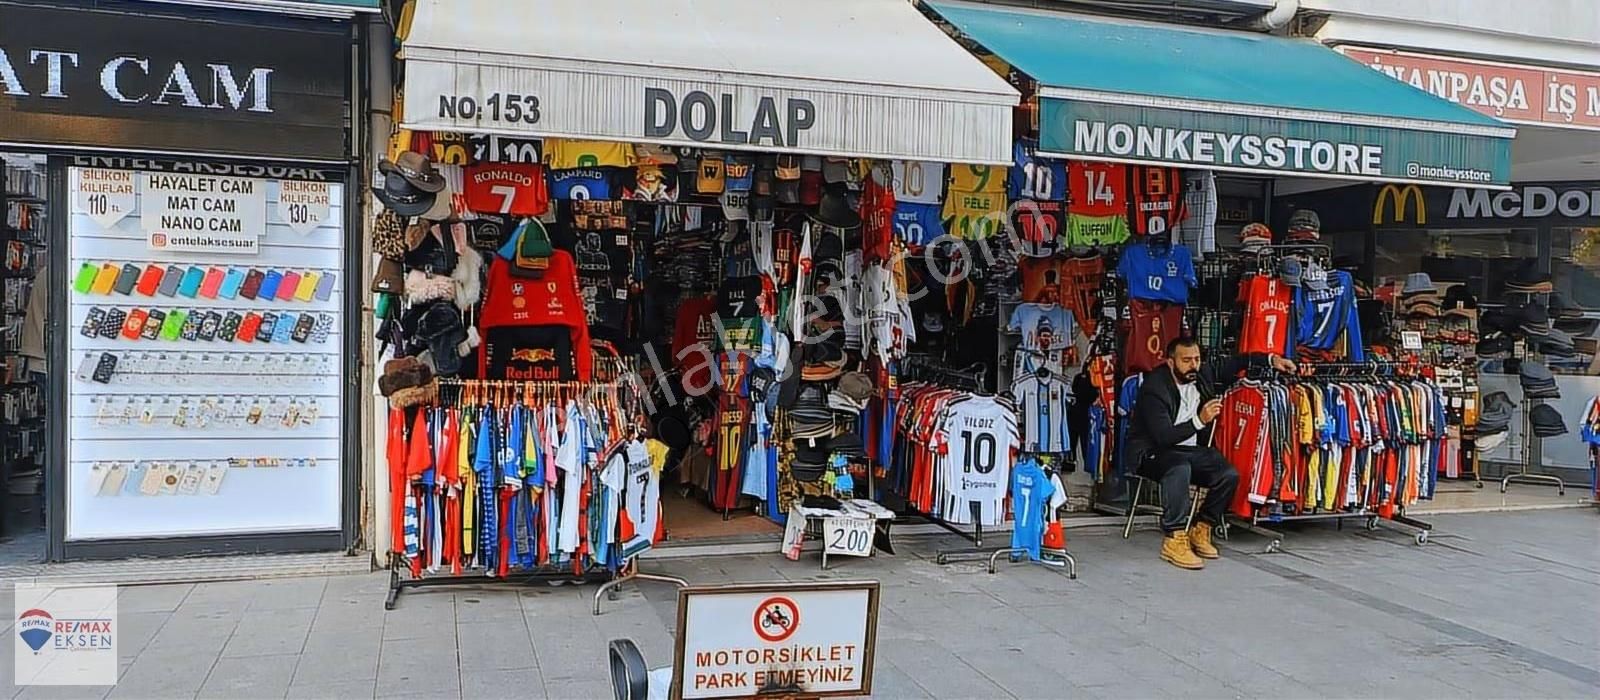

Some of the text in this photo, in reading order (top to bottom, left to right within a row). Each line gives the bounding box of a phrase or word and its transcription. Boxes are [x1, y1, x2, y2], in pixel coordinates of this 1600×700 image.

[100, 56, 275, 112] CAM
[1364, 56, 1529, 116] ANPAŞA
[1548, 75, 1577, 122] İŞ
[643, 87, 816, 147] DOLAP
[1073, 119, 1383, 176] MONKEYSSTORE
[149, 175, 254, 195] HAYALET CAM
[473, 170, 533, 187] RONALDO
[553, 169, 603, 182] LAMPARD
[1420, 165, 1491, 182] monkeysstore
[80, 181, 133, 195] KILIFLAR
[280, 193, 329, 206] KILIFLAR
[490, 185, 517, 213] 7
[1084, 170, 1115, 207] 14
[87, 195, 107, 216] 110
[167, 196, 235, 213] MAT CAM
[287, 204, 308, 224] 130
[963, 197, 991, 210] PELE
[1447, 187, 1600, 219] McDo
[160, 216, 241, 233] NANO CAM
[170, 237, 255, 249] entelaksesuar
[1313, 301, 1335, 338] 7
[1265, 315, 1277, 349] 7
[506, 366, 559, 379] Red Bull
[721, 425, 741, 470] 10
[961, 430, 997, 475] 10
[829, 528, 869, 552] 200
[696, 644, 856, 668] MOTORSİKLET
[695, 666, 854, 690] PARK ETMEYİNİZ
